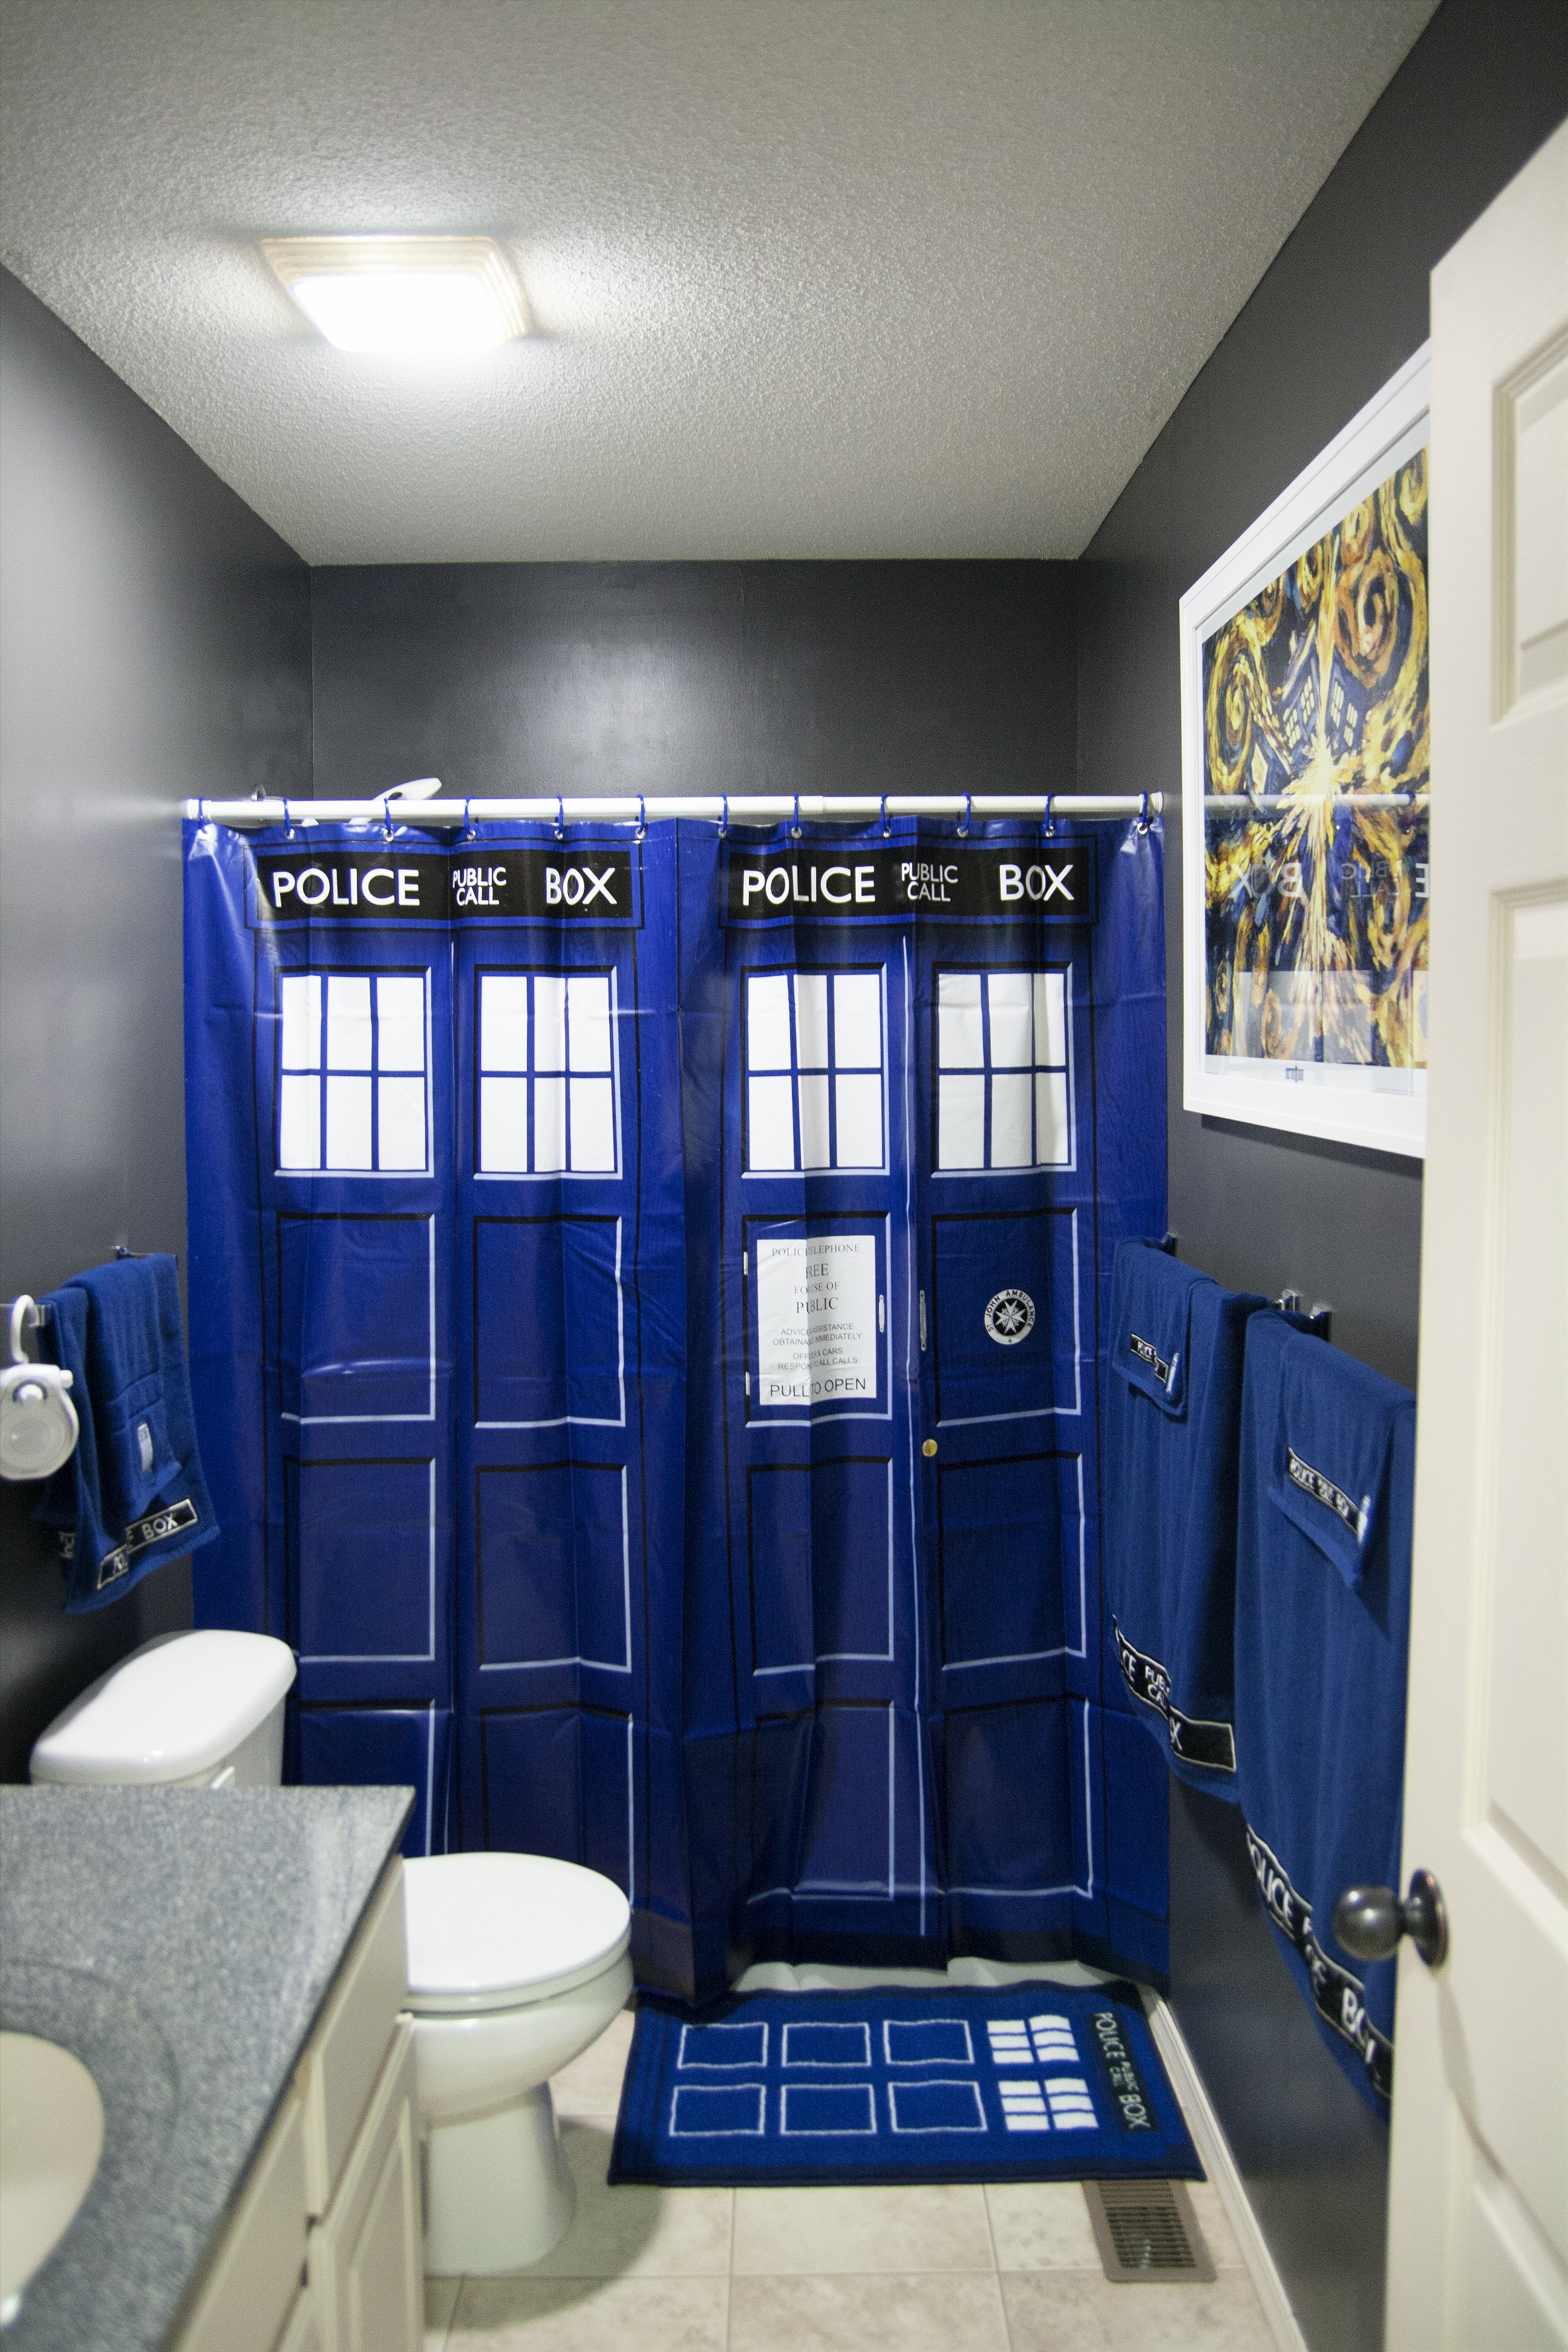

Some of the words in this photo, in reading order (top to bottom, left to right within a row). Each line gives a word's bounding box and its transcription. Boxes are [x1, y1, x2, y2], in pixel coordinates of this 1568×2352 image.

[272, 867, 420, 907] POLICE
[452, 867, 507, 889] PUBLIC
[546, 867, 618, 905] BOX
[743, 865, 875, 906] POLICE
[901, 863, 959, 884] PUBLIC
[999, 864, 1075, 901] BOX
[456, 886, 500, 906] CALL
[907, 881, 951, 902] CALL
[826, 1281, 840, 1290] OF
[987, 1295, 1001, 1318] JOHN
[1006, 1290, 1034, 1327] AMBULANCE
[770, 1385, 809, 1397] PULL
[825, 1378, 866, 1392] OPEN
[141, 1512, 178, 1541] BOX
[1095, 2012, 1126, 2059] POLICE
[1119, 2094, 1151, 2129] BOX
